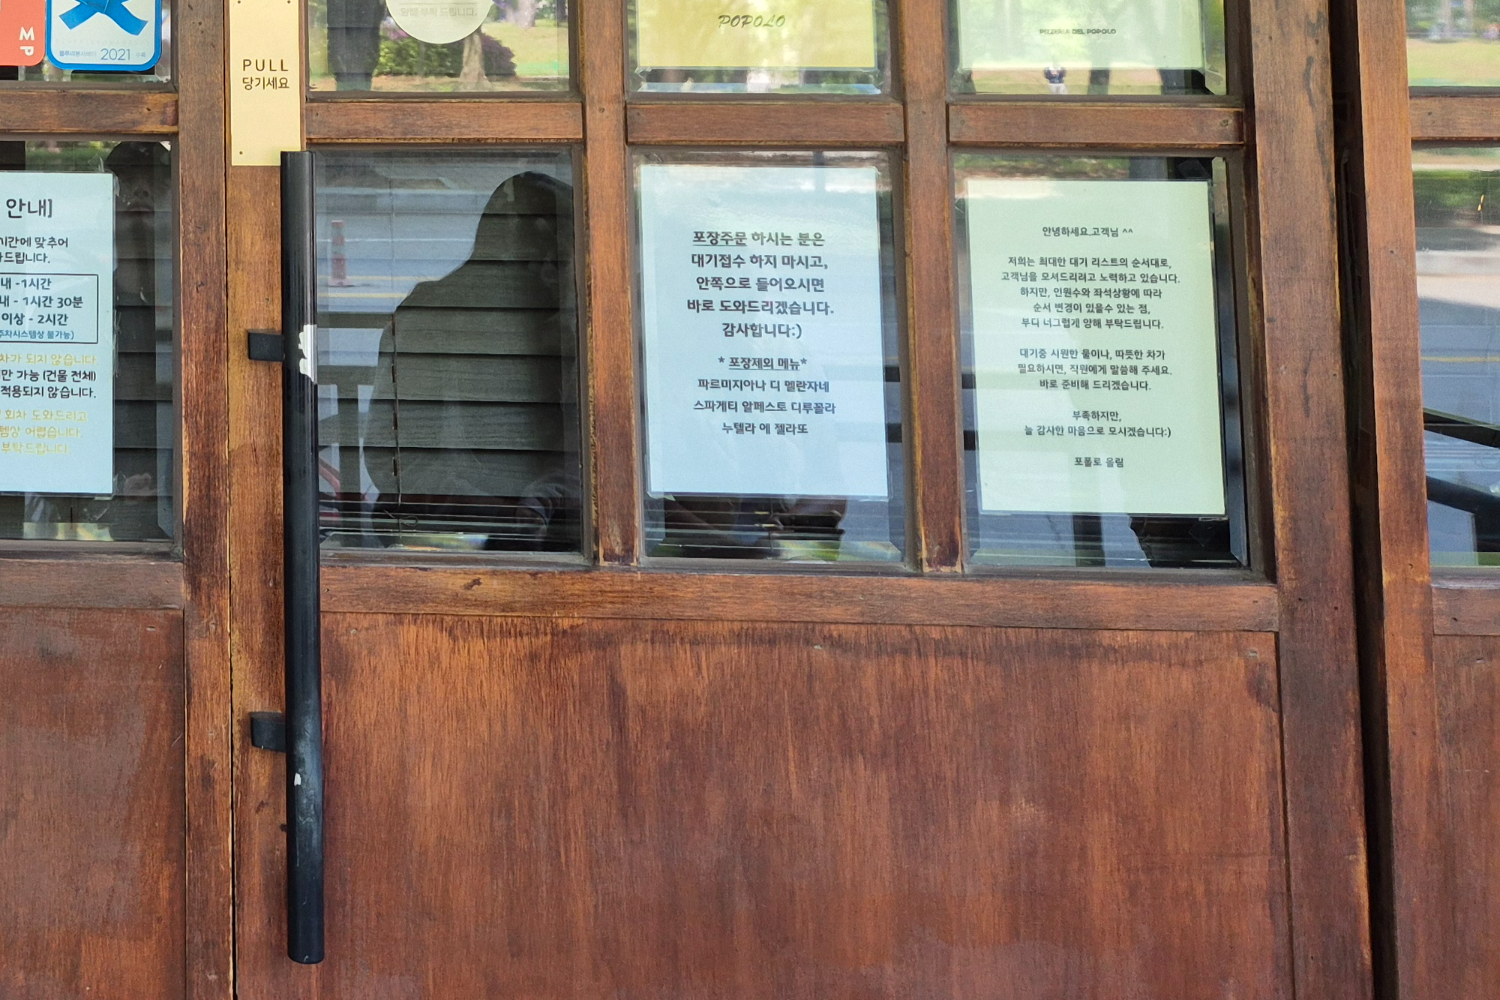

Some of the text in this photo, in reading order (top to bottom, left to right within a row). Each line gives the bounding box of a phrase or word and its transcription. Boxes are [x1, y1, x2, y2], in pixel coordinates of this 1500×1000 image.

[718, 15, 785, 28] POPOLO
[101, 48, 130, 60] 2021
[243, 59, 288, 71] PULL
[243, 77, 289, 90] 당기세요
[6, 198, 52, 218] 안내]
[693, 231, 825, 246] 포장주문 하시는 분은
[692, 254, 828, 269] 대기접수 하지 마시고,
[696, 277, 824, 292] 안쪽으로 들어오시면
[23, 296, 53, 308] 1시간
[57, 296, 83, 308] 30분
[688, 300, 833, 315] 바로 도와드리겠습니다.
[2, 313, 25, 325] 이상
[38, 314, 68, 326] 2시간
[17, 370, 39, 382] 가능
[1, 385, 44, 398] 적용되지
[48, 386, 96, 398] 않습니다.
[1073, 411, 1121, 422] 부족하지만,
